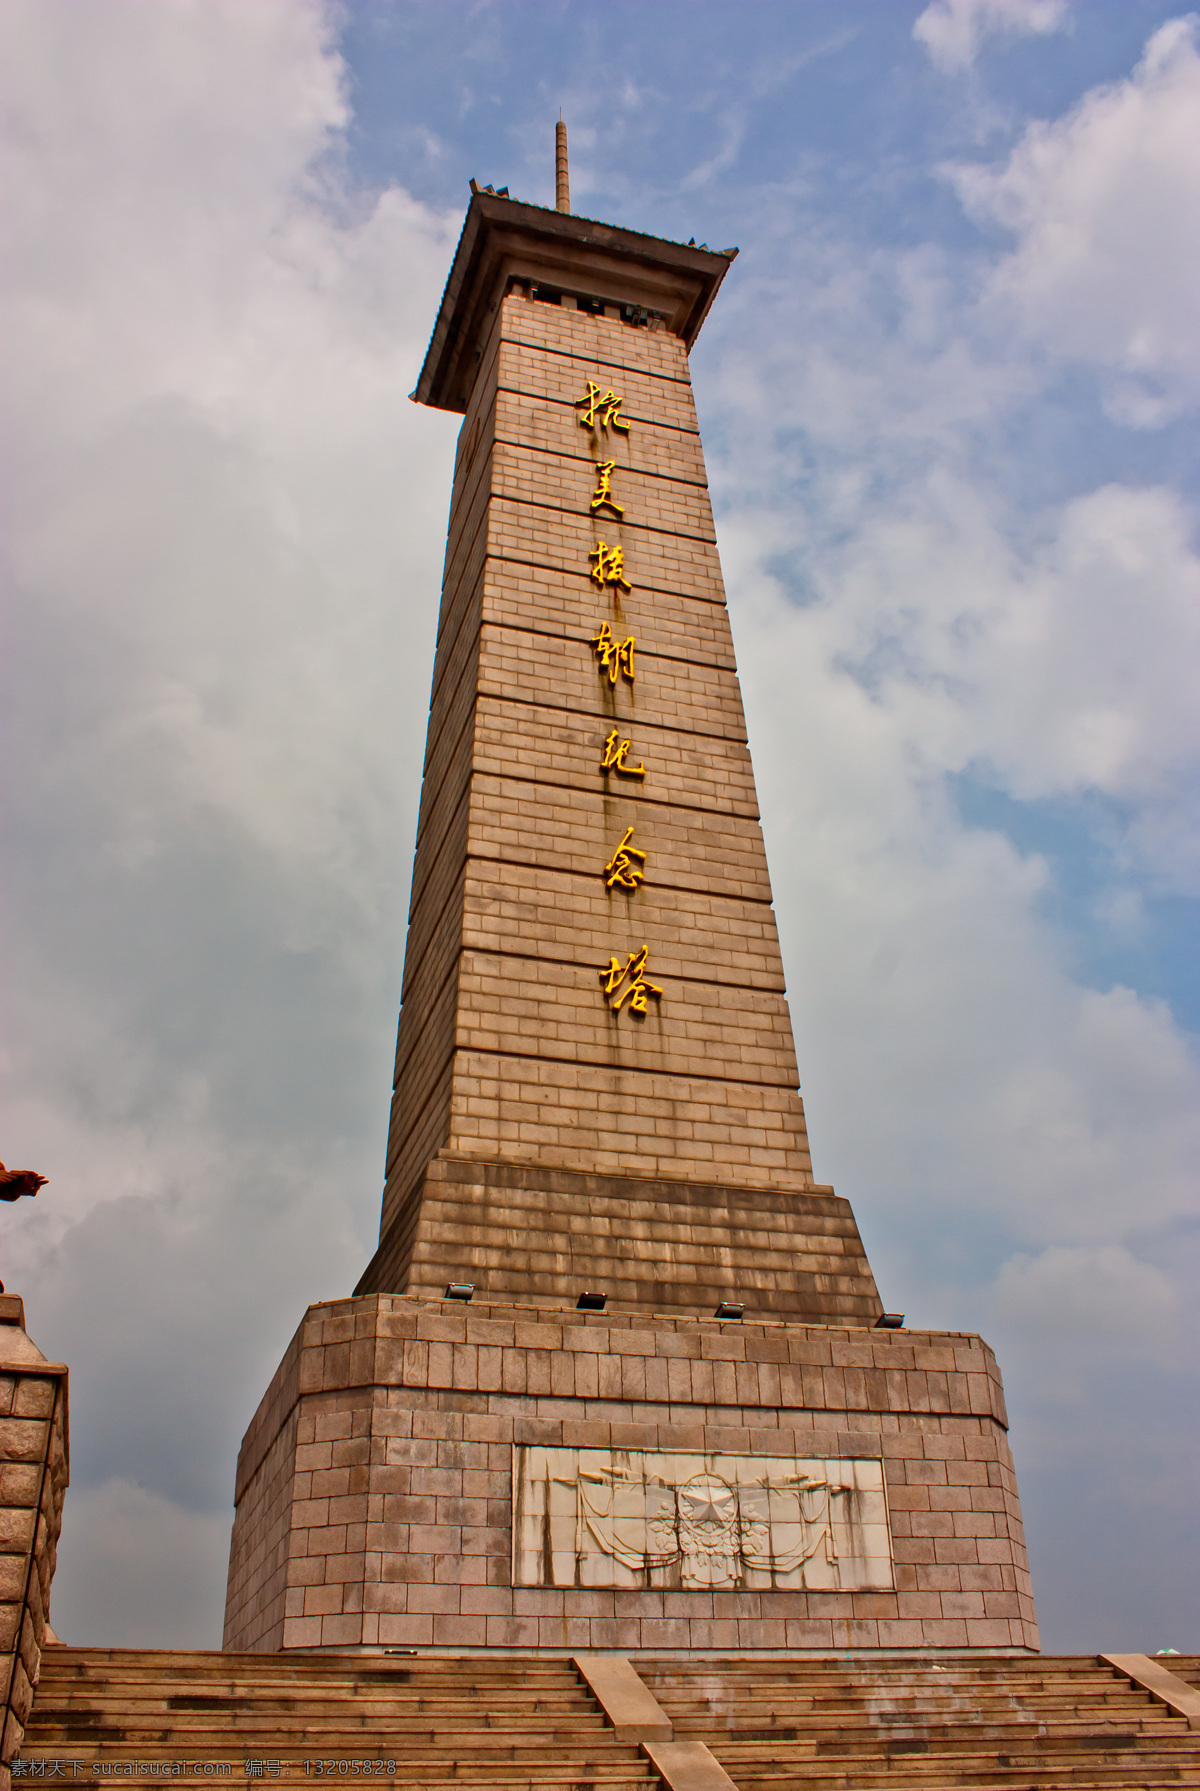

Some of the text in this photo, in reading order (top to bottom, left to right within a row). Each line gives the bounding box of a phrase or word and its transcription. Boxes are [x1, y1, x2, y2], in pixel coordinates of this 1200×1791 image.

[577, 380, 663, 1015] 抗美援朝纪念塔
